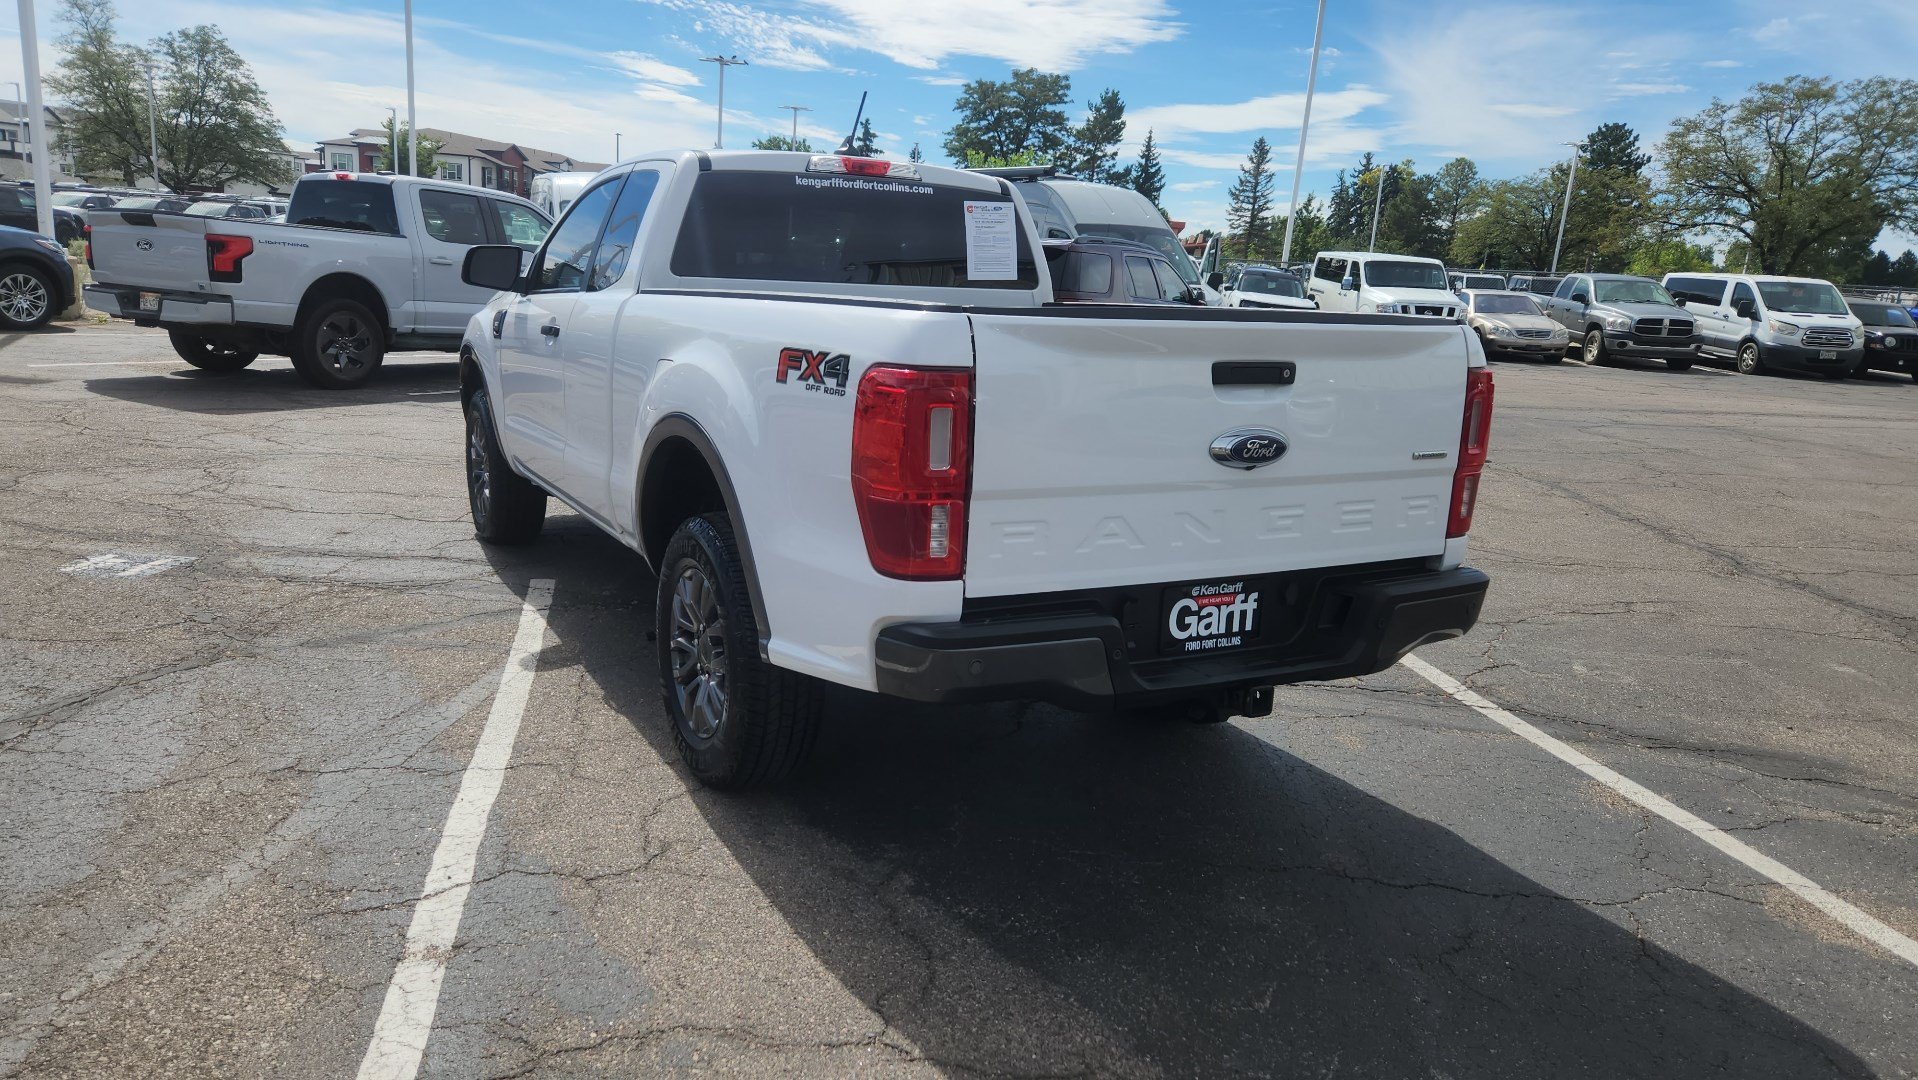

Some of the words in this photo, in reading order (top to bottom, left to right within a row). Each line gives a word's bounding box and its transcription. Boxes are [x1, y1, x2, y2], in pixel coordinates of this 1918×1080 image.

[795, 175, 934, 195] kengarfffordfortcollins.com
[258, 239, 310, 248] LIGHTNING
[776, 347, 851, 388] FX4
[805, 383, 822, 392] OFF
[823, 386, 846, 397] ROAD
[1243, 439, 1277, 458] Ford
[989, 494, 1439, 558] RANGER
[1200, 584, 1219, 596] Ken
[1219, 581, 1244, 594] Garff
[1168, 592, 1259, 640] Garff
[1185, 639, 1201, 651] FORD
[1202, 638, 1217, 649] FORT
[1217, 636, 1241, 648] COLLINS
